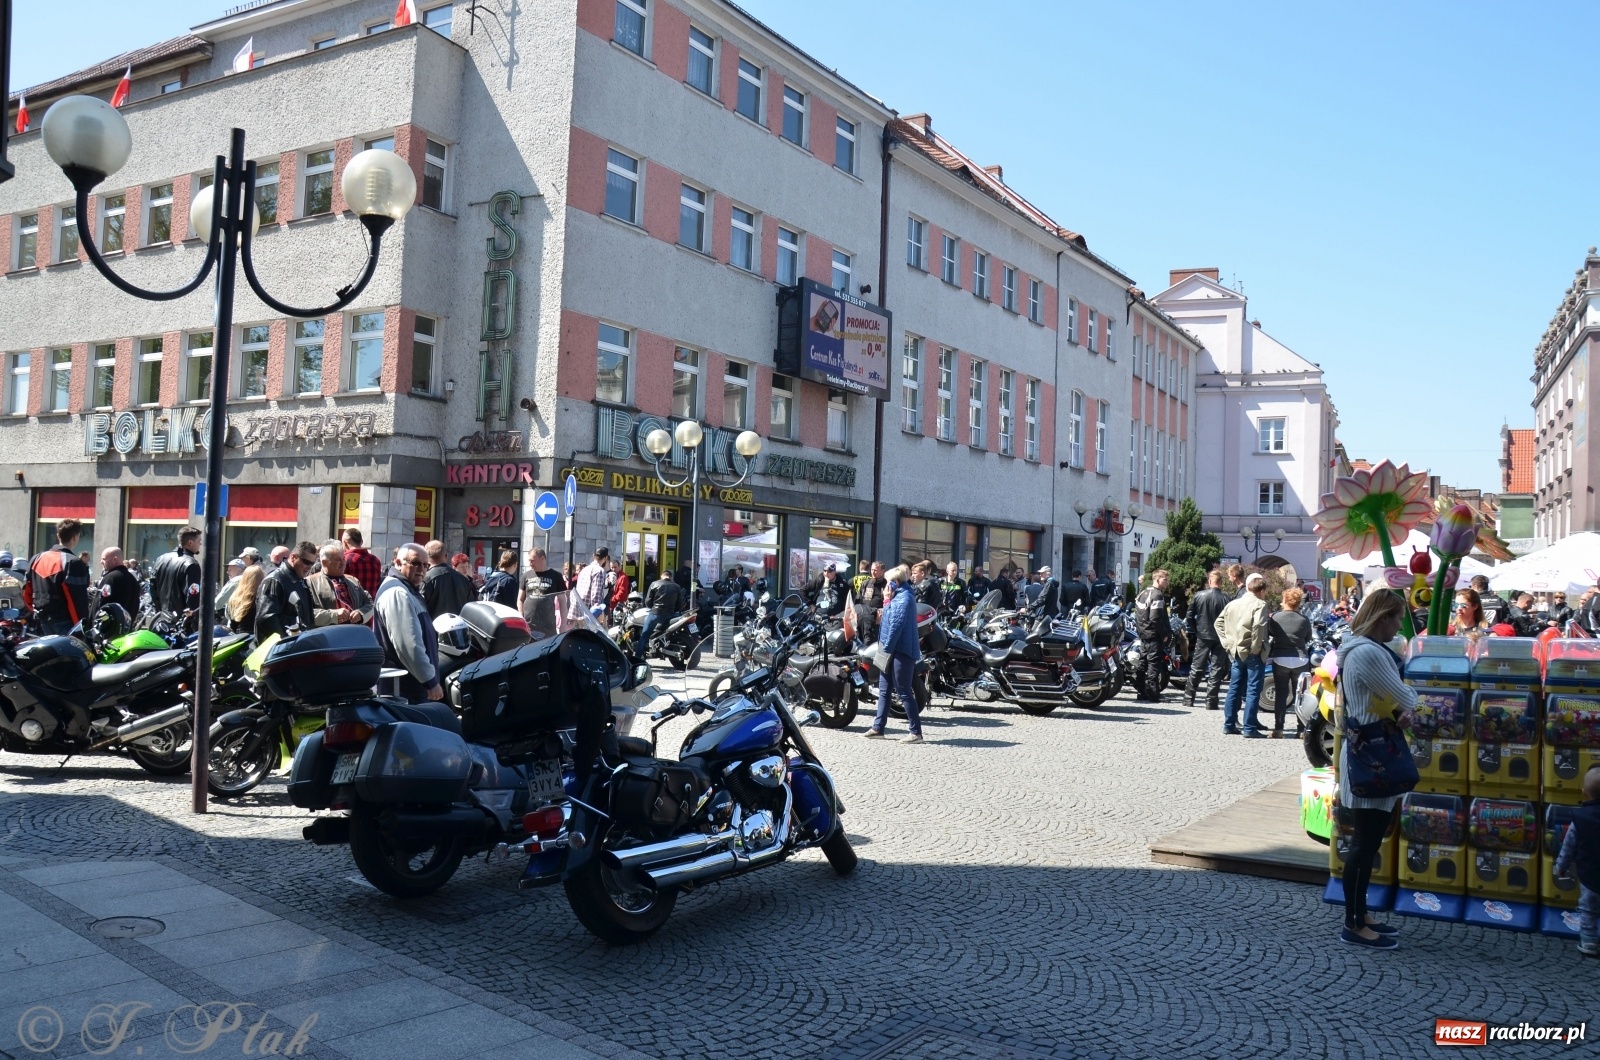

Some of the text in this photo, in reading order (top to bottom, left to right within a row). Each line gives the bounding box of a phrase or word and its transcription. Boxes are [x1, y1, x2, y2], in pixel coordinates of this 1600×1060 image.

[846, 316, 880, 331] PROMOCJA:
[810, 344, 828, 363] Centrum
[828, 350, 837, 366] Kas
[245, 411, 377, 443] zaprasza
[446, 462, 535, 485] KANTOR
[768, 453, 857, 488] zaprasza
[465, 504, 514, 528] 8-20
[531, 777, 561, 793] 3VY4
